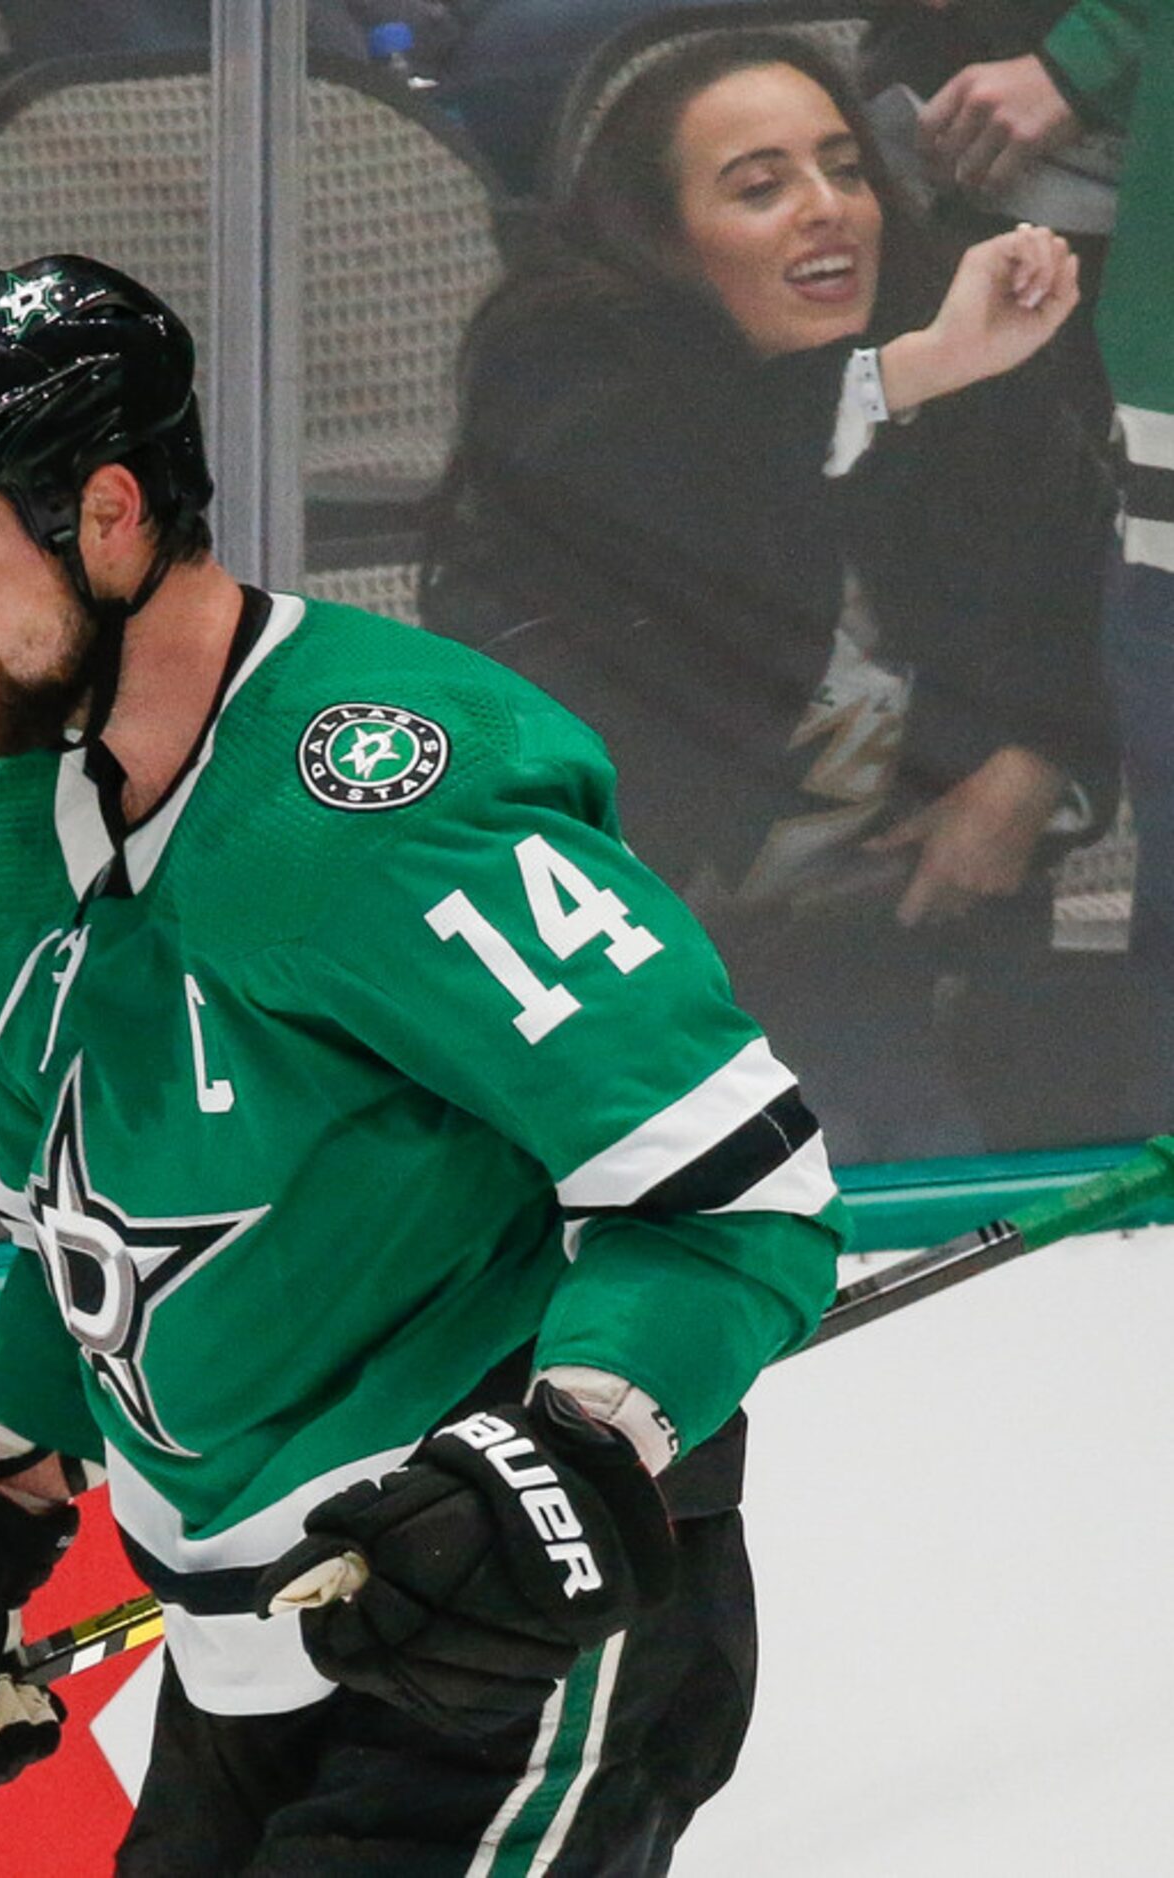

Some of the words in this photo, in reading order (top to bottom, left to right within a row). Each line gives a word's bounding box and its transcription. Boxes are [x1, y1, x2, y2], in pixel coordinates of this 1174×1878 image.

[308, 708, 412, 780] DALLAS
[346, 740, 439, 802] STARS
[423, 833, 665, 1046] 14
